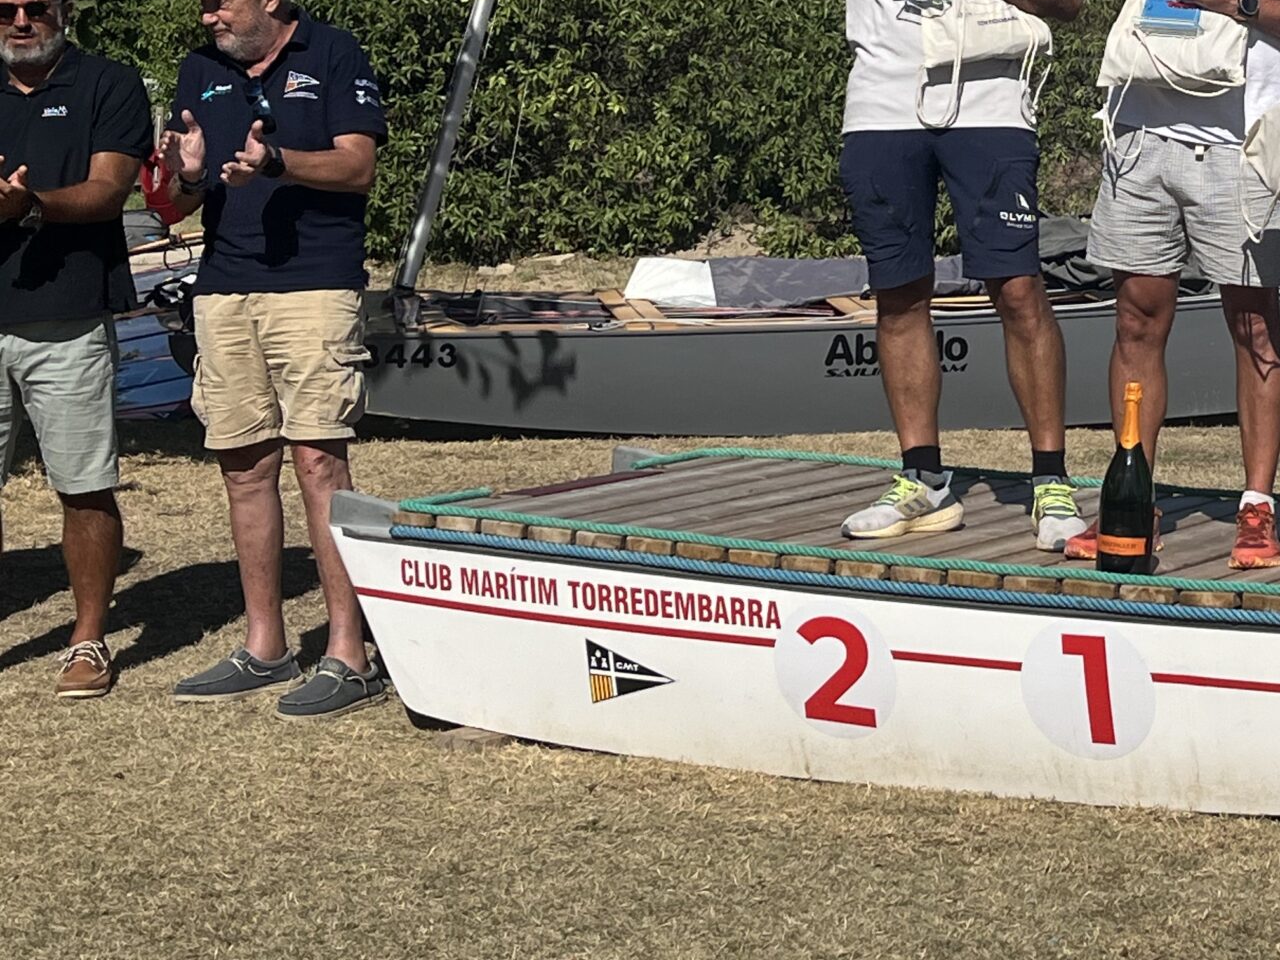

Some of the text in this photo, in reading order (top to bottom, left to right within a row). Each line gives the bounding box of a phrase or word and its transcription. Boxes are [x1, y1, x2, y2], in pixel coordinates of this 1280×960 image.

[401, 558, 781, 629] CLUB MARÍTIM TORREDEMBARRA
[616, 661, 639, 672] CMT
[796, 616, 877, 728] 2
[1061, 633, 1116, 745] 1
